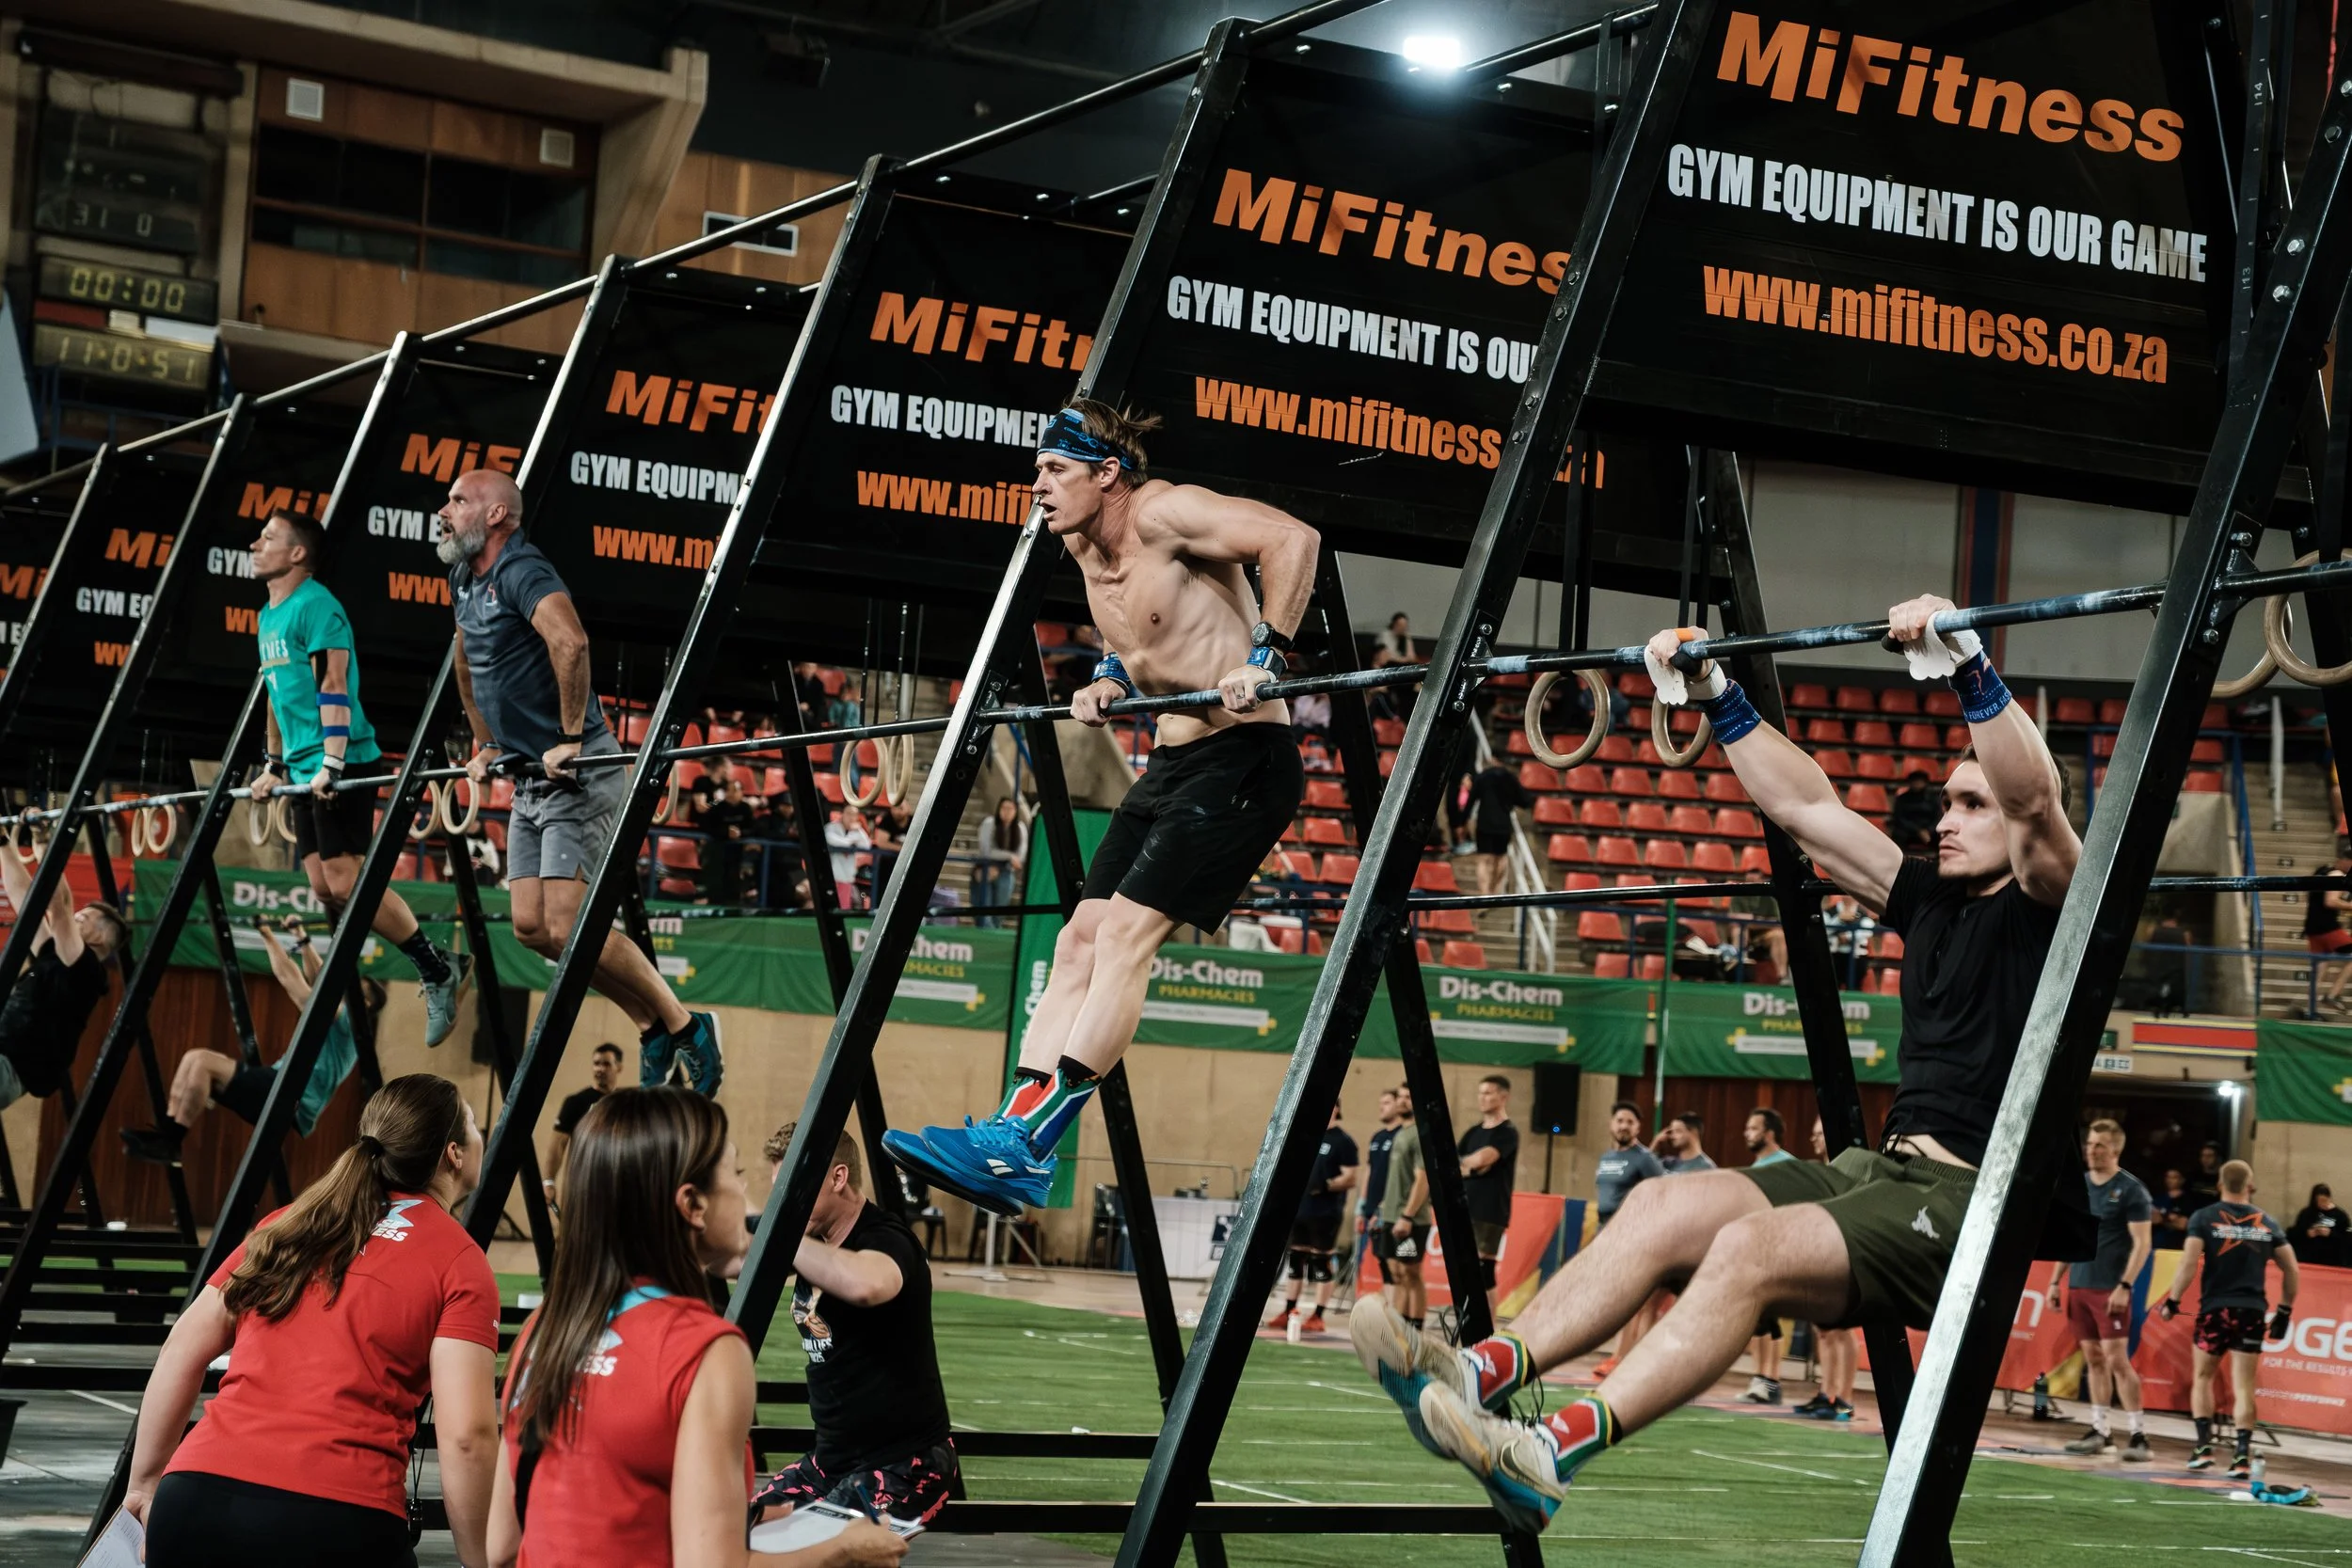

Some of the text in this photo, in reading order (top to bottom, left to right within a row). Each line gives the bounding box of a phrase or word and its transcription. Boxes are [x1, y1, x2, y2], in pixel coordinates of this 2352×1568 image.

[1717, 12, 2184, 162] MiFitness
[1213, 168, 1572, 295] MiFitnes
[1668, 144, 2207, 282] GYM EQUIPMENT IS OUR GAME
[69, 266, 186, 313] 00:00
[869, 292, 1094, 372] MiFit
[1168, 275, 1244, 330] GYM
[1250, 291, 1441, 366] EQUIPMENT
[1446, 328, 1480, 374] IS
[1704, 265, 2168, 384] www.mifitness.co.za
[605, 370, 776, 435] MiFit
[831, 385, 899, 430] GYM
[906, 394, 1056, 455] EQUIPMEN
[570, 451, 631, 491] GYM
[636, 460, 744, 505] EQUIPM
[367, 505, 424, 541] GYM
[75, 587, 125, 617] GYM
[232, 881, 326, 914] Dis-Ch
[1439, 975, 1564, 1007] Dis-Chem
